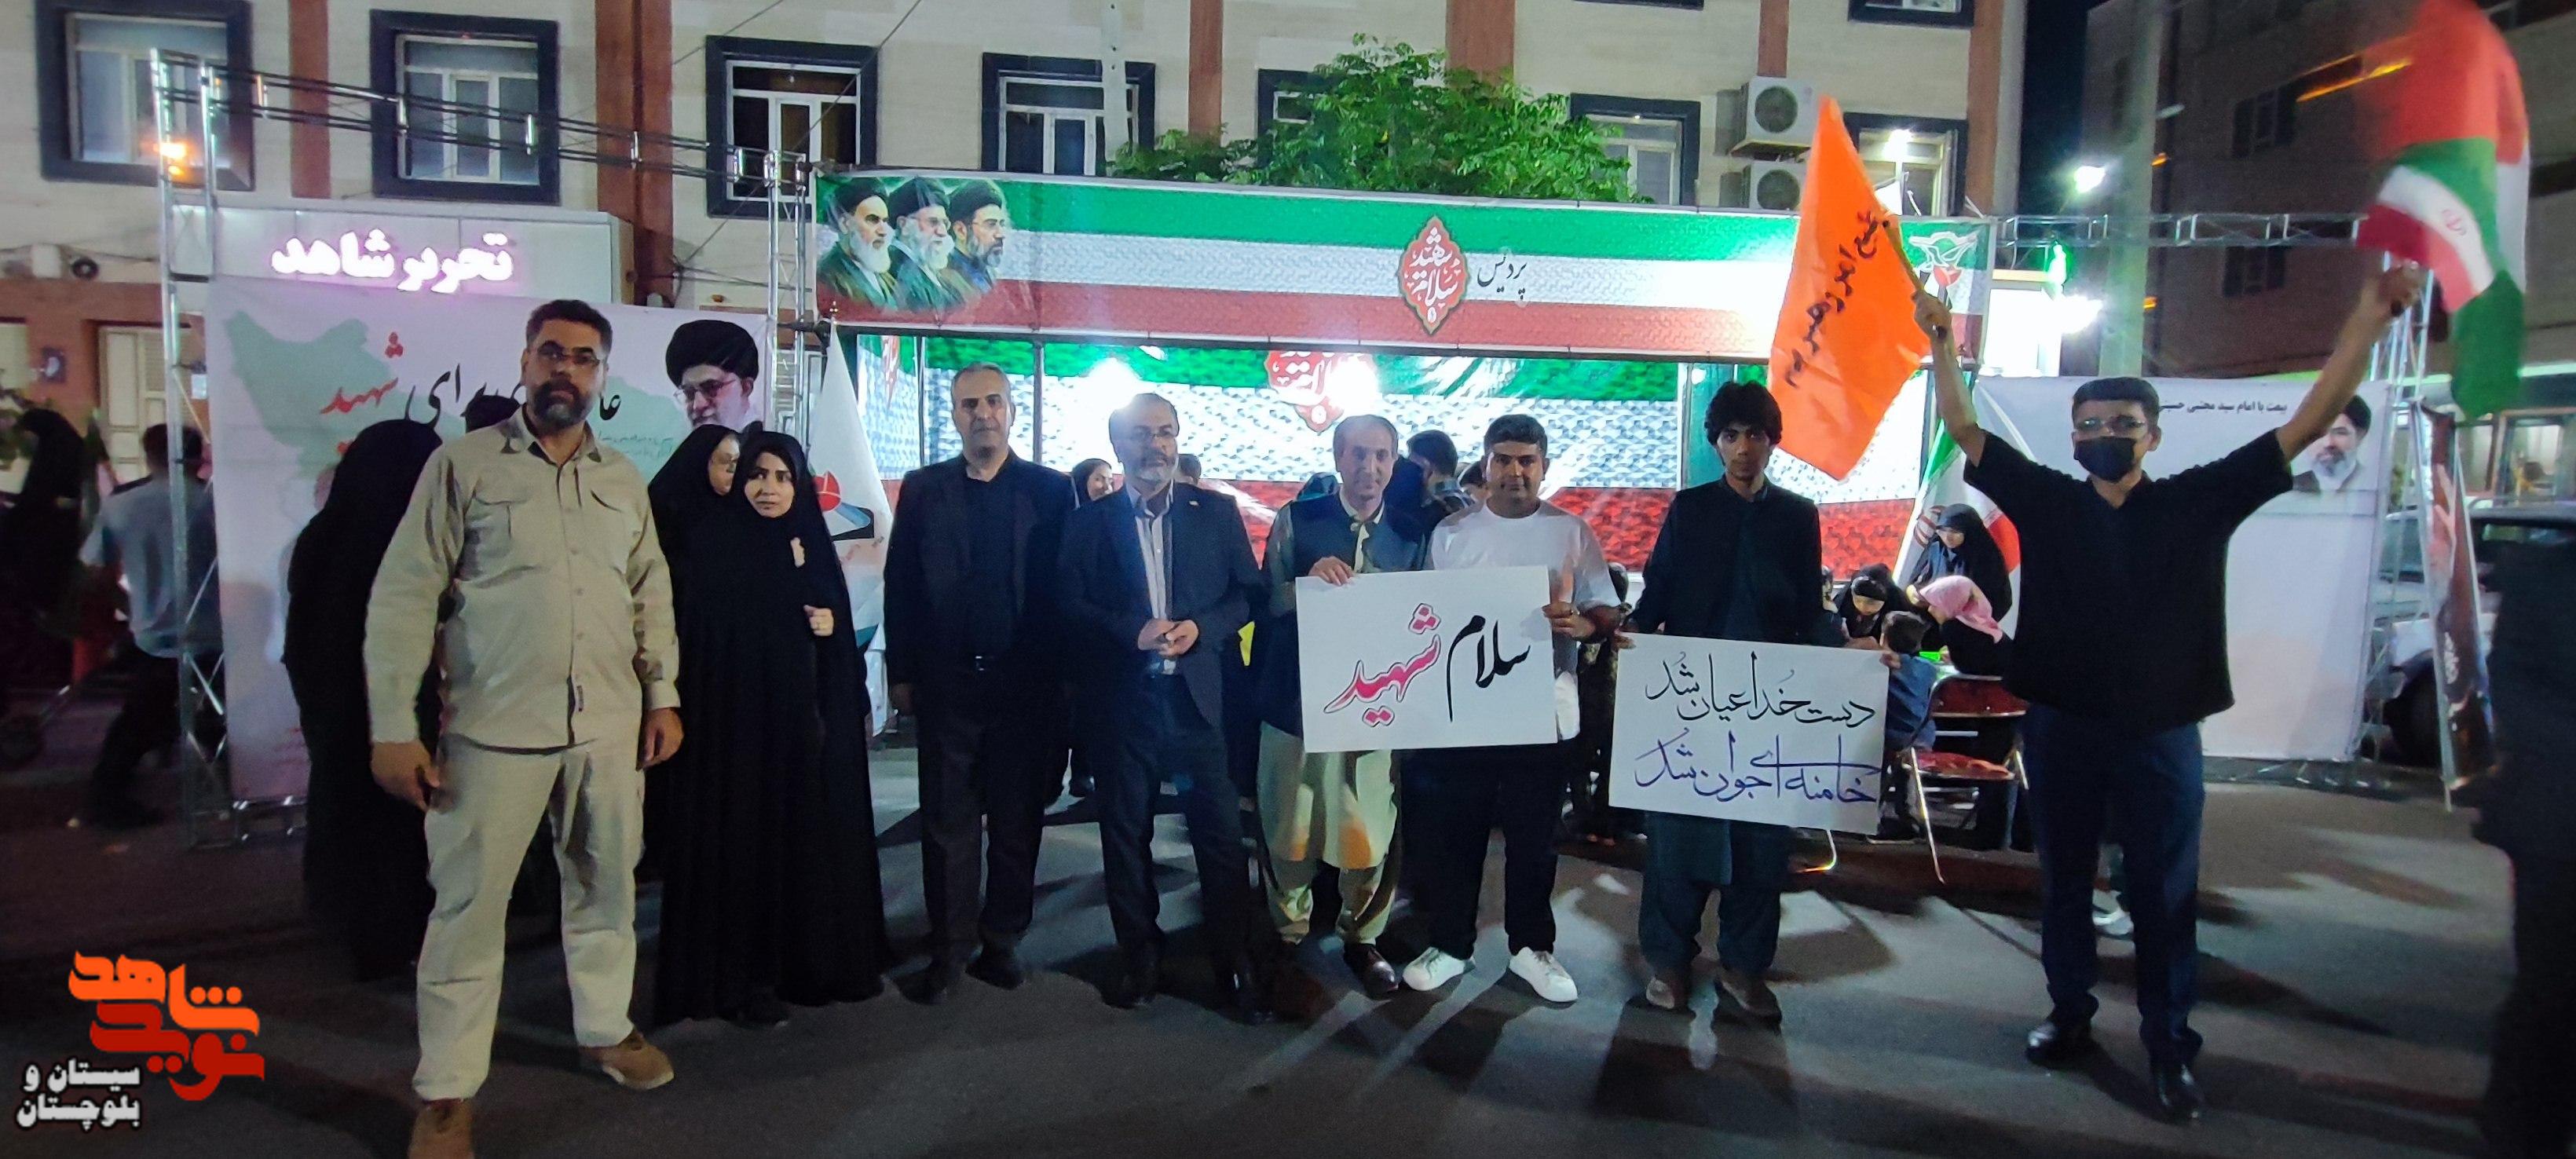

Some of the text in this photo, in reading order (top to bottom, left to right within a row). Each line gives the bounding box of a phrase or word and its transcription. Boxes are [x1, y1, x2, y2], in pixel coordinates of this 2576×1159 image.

[271, 228, 395, 278] شاهد
[1476, 253, 1528, 300] پردیس
[2159, 399, 2186, 414] حسین
[1323, 602, 1531, 728] سلام شهید
[1676, 653, 1751, 722] عیان
[1795, 700, 1876, 729] دست
[1693, 729, 1773, 803] جوان
